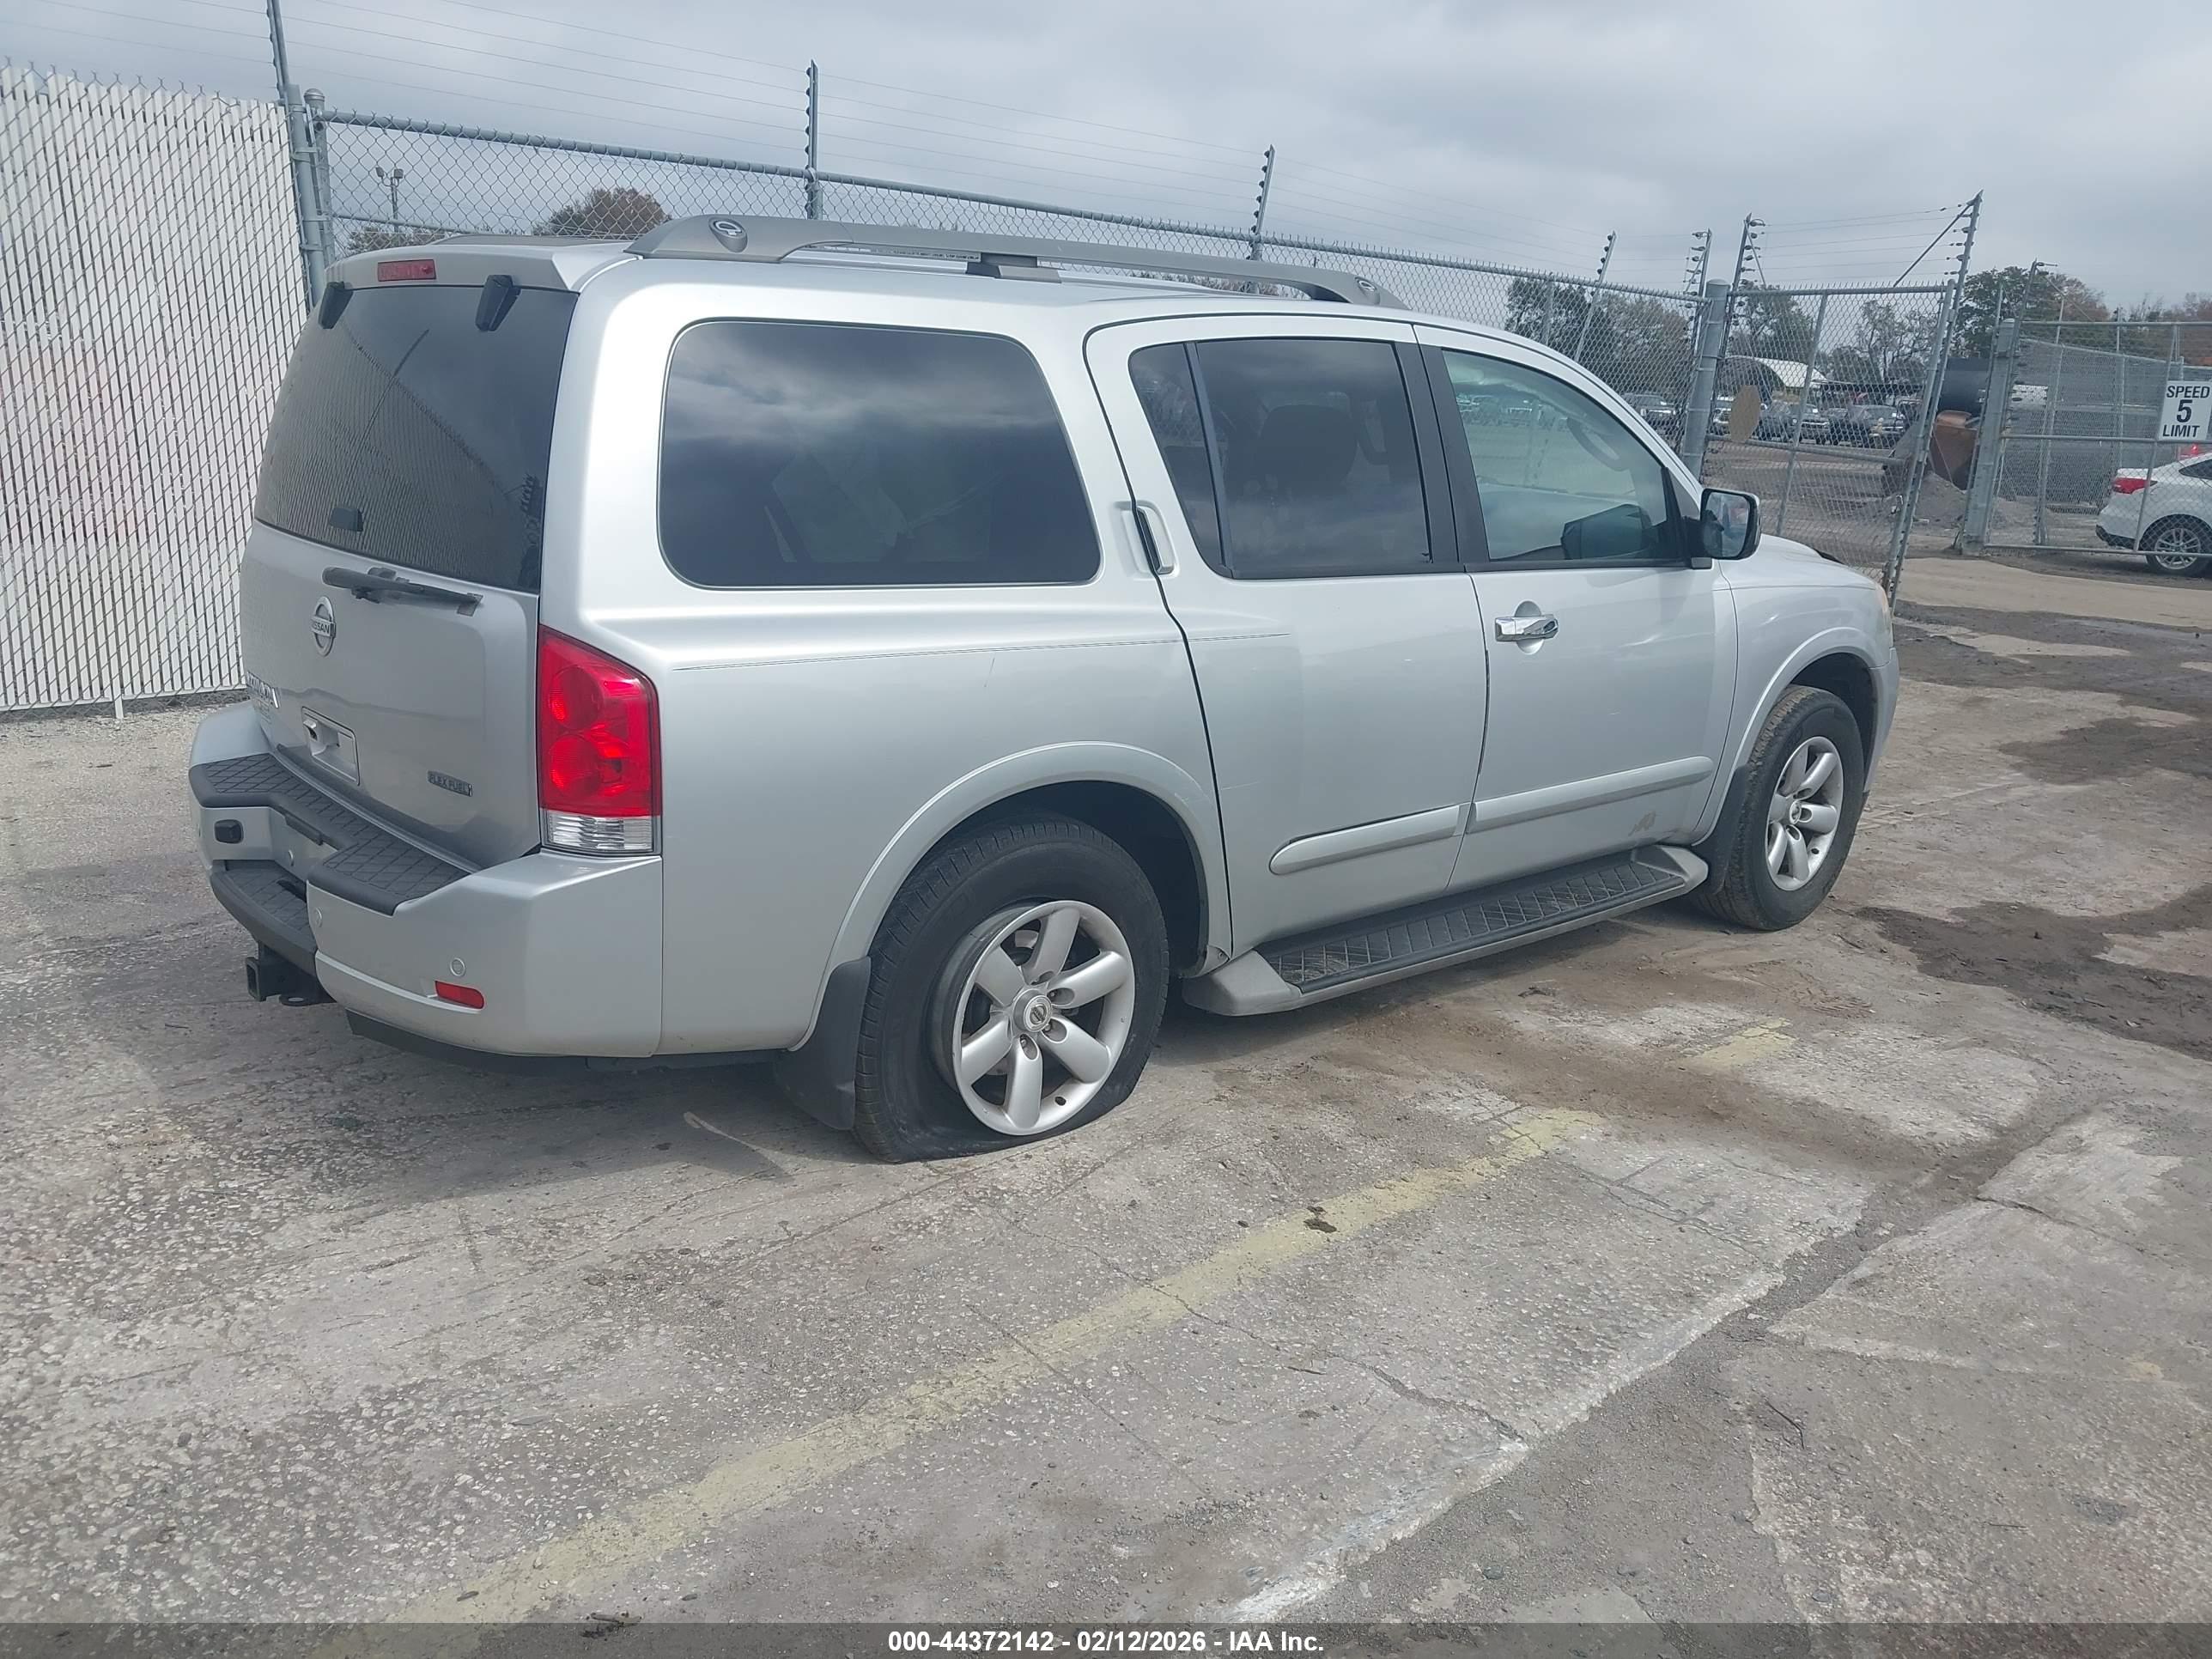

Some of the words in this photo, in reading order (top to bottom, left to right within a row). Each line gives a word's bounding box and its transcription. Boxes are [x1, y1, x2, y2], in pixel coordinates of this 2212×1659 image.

[2166, 385, 2210, 398] SPEED
[2176, 398, 2193, 422] 5
[2162, 424, 2200, 438] LIMIT
